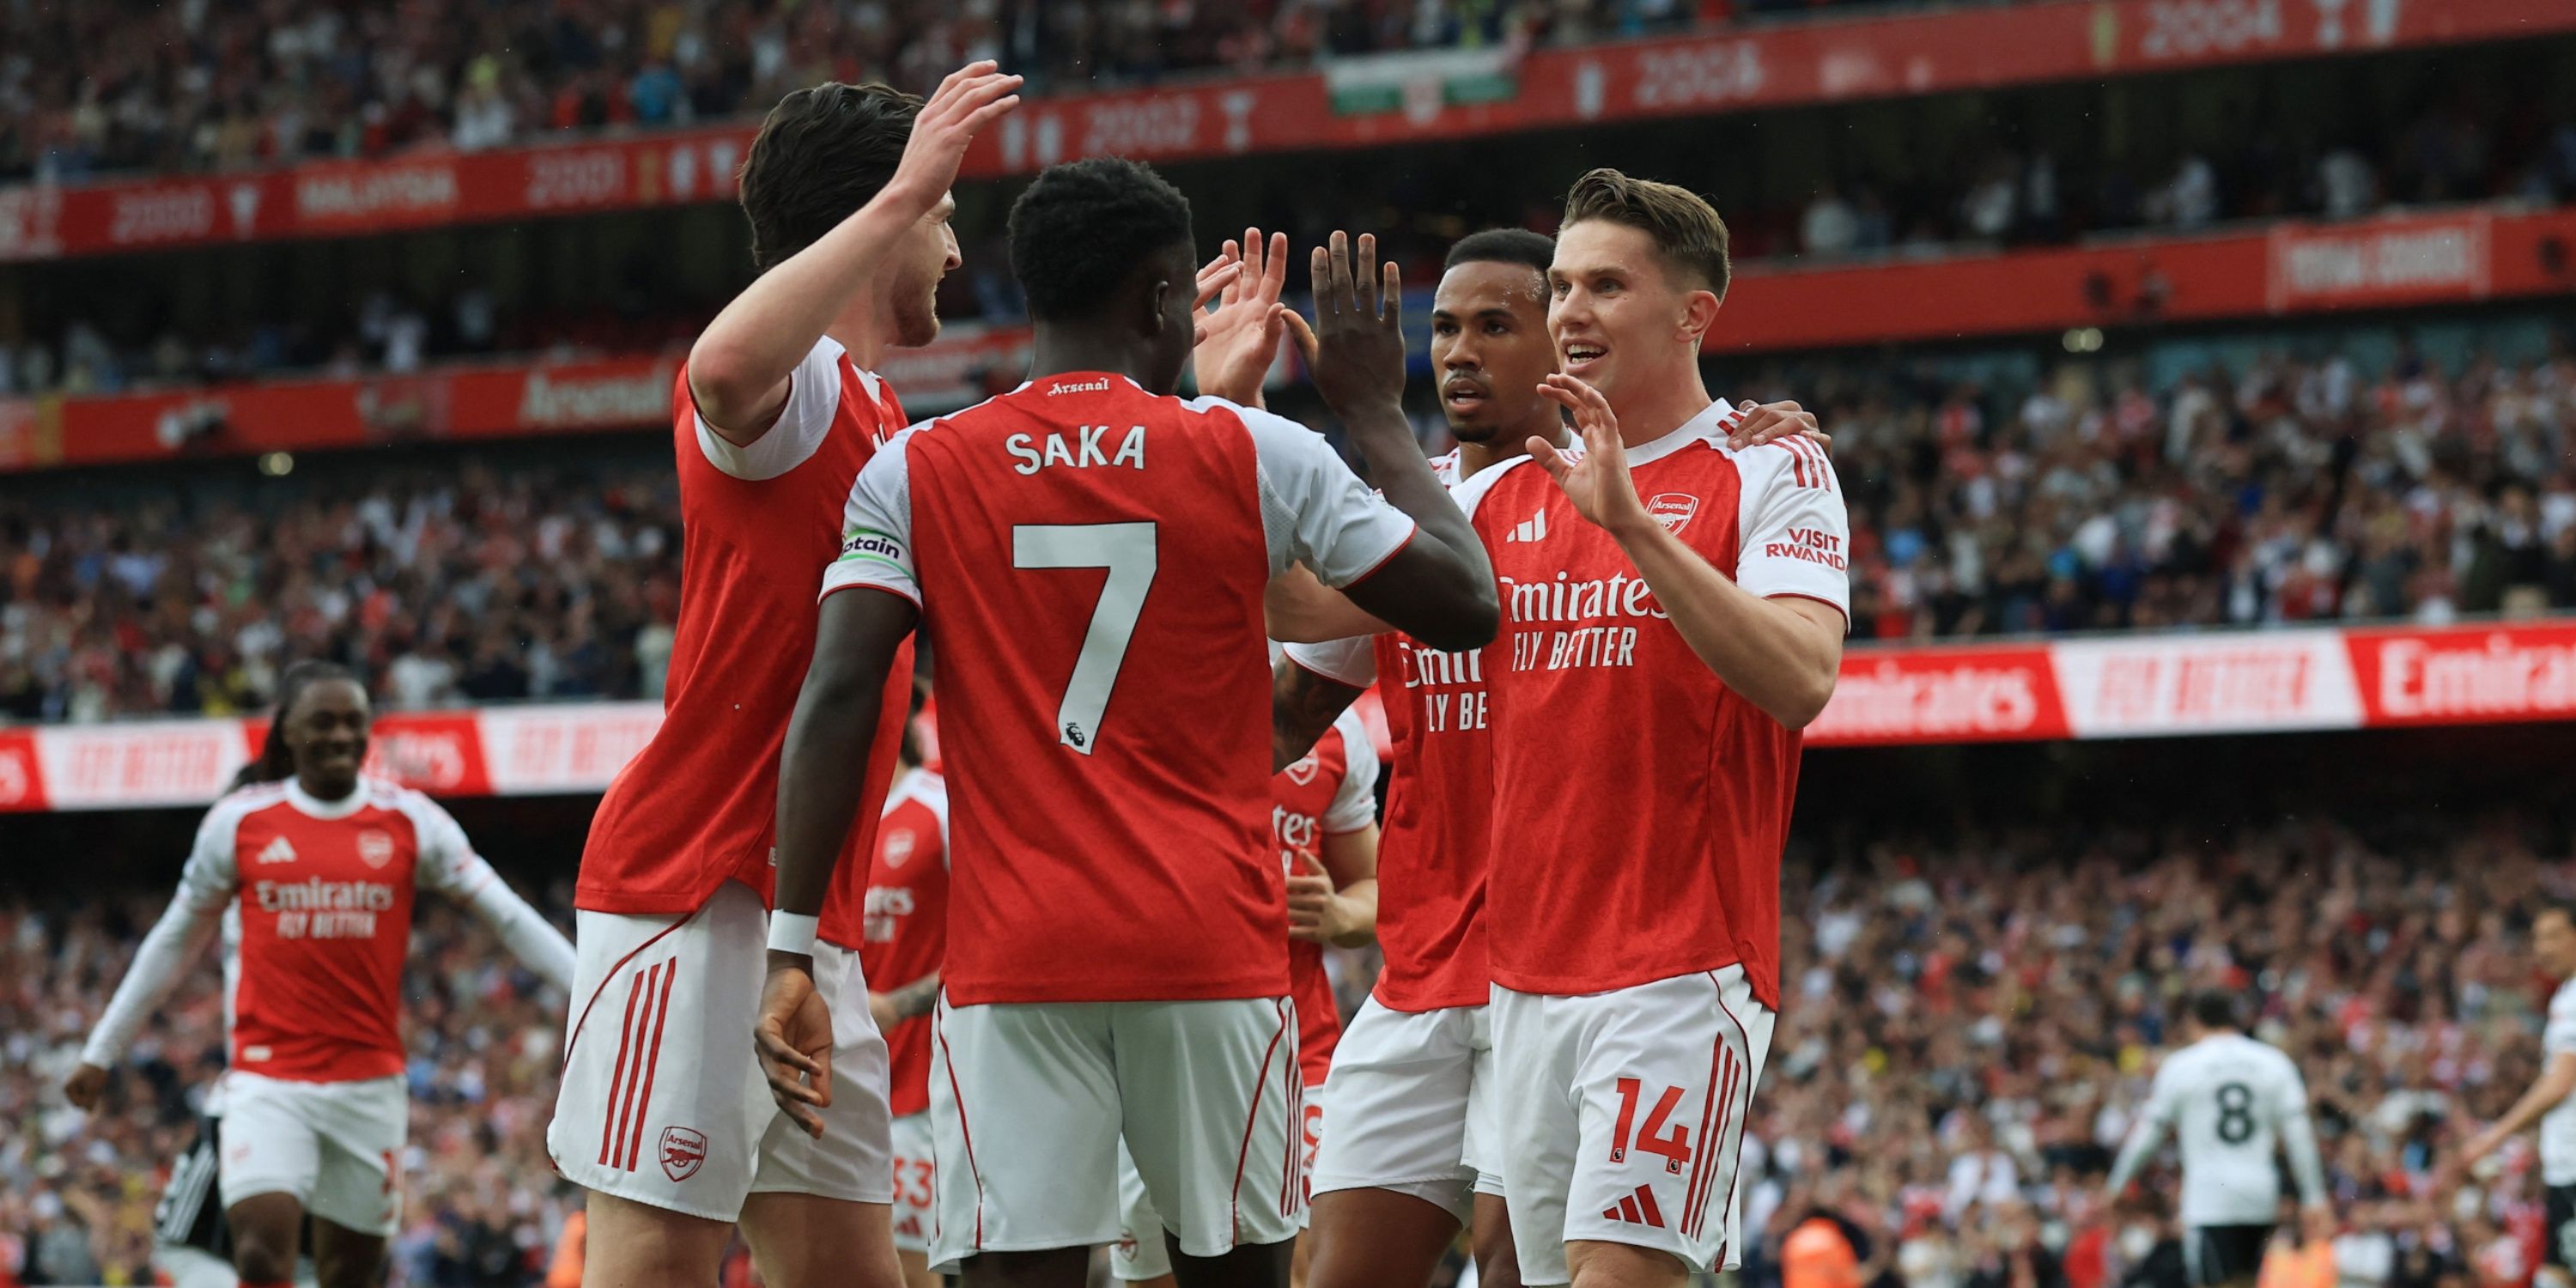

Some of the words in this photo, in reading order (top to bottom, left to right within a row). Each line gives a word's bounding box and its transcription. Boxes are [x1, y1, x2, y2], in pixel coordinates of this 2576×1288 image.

[517, 369, 668, 423] Arsenal
[1047, 377, 1109, 397] Arsenal
[1005, 425, 1146, 476] SAKA
[1654, 501, 1691, 511] Arsenal
[1765, 543, 1848, 575] RWAND
[1788, 528, 1840, 551] VISIT
[1013, 521, 1157, 756] 7
[1512, 631, 1543, 671] FLY
[1547, 627, 1637, 671] BETTER
[1425, 694, 1449, 732] LY
[1804, 661, 2038, 738] mirates
[1609, 1078, 1692, 1176] 14
[2215, 1081, 2254, 1146] 8
[667, 1134, 702, 1150] Arsenal
